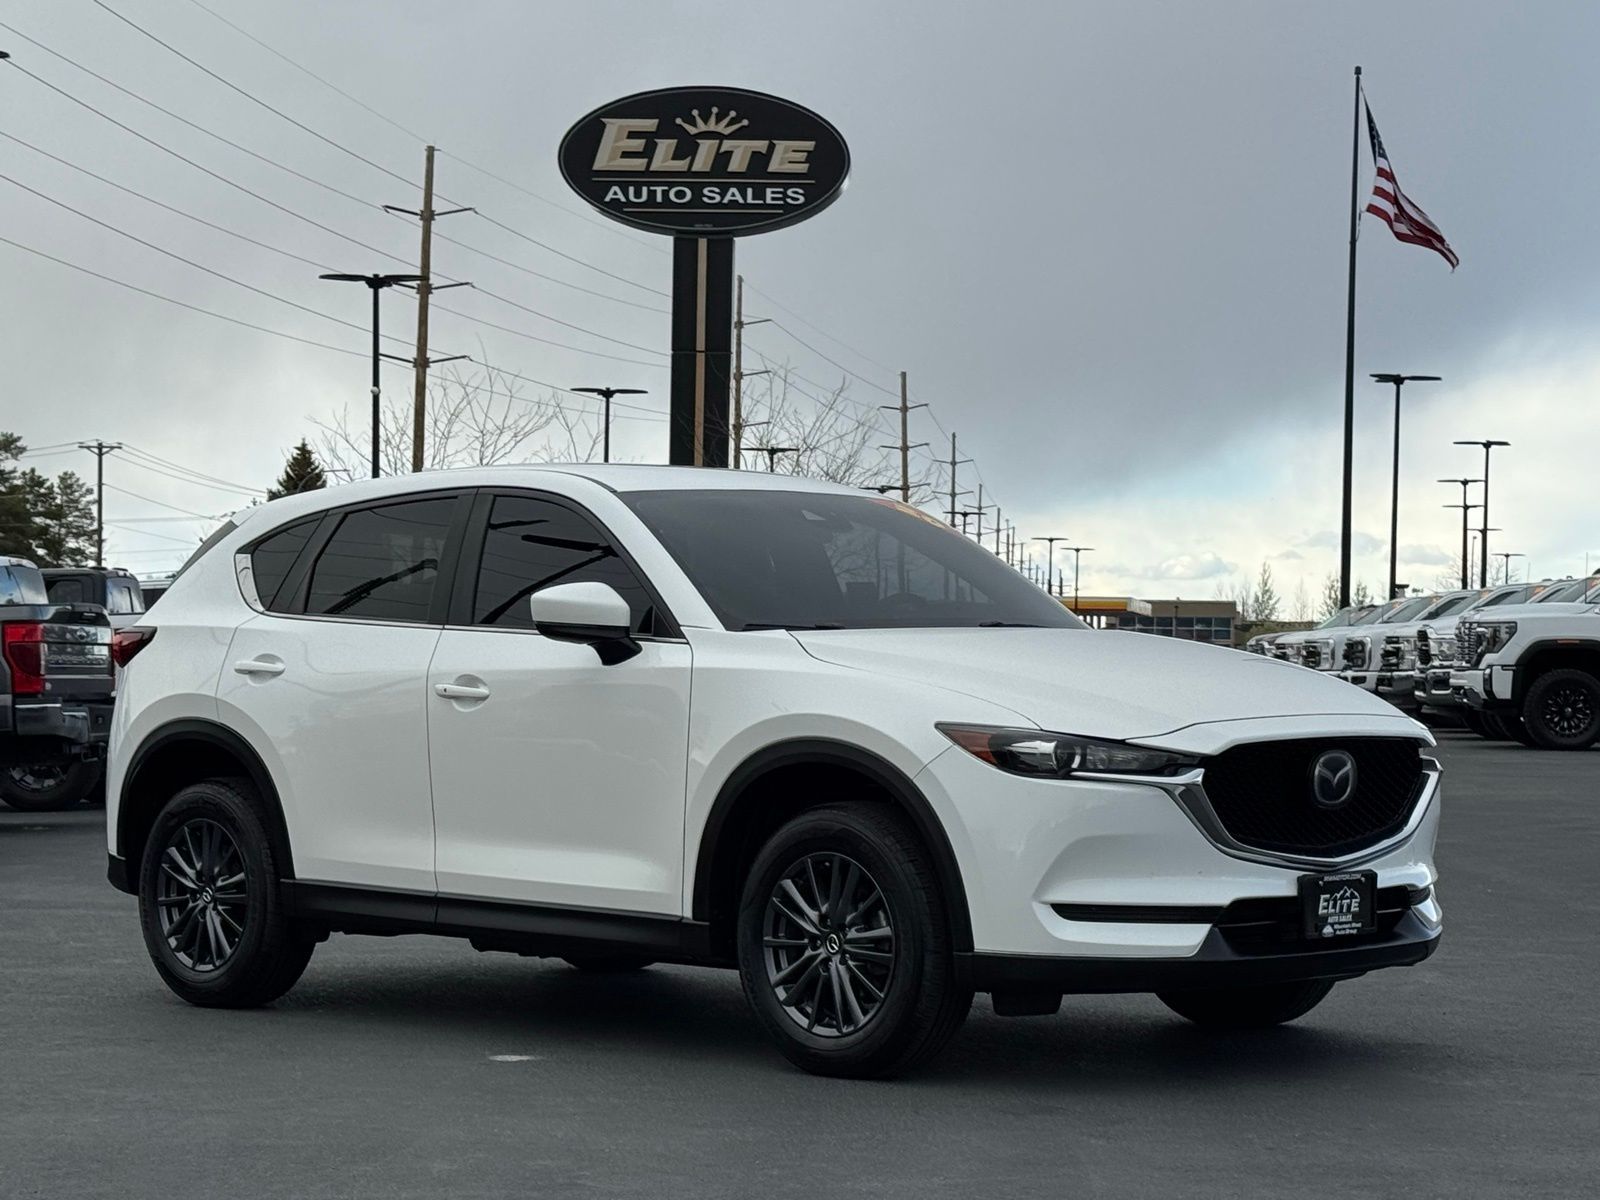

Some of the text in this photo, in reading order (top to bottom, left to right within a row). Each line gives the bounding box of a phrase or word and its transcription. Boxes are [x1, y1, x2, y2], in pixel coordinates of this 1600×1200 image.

[592, 118, 816, 173] ELITE
[604, 186, 806, 205] AUTO SALES
[1319, 894, 1360, 915] ELITE
